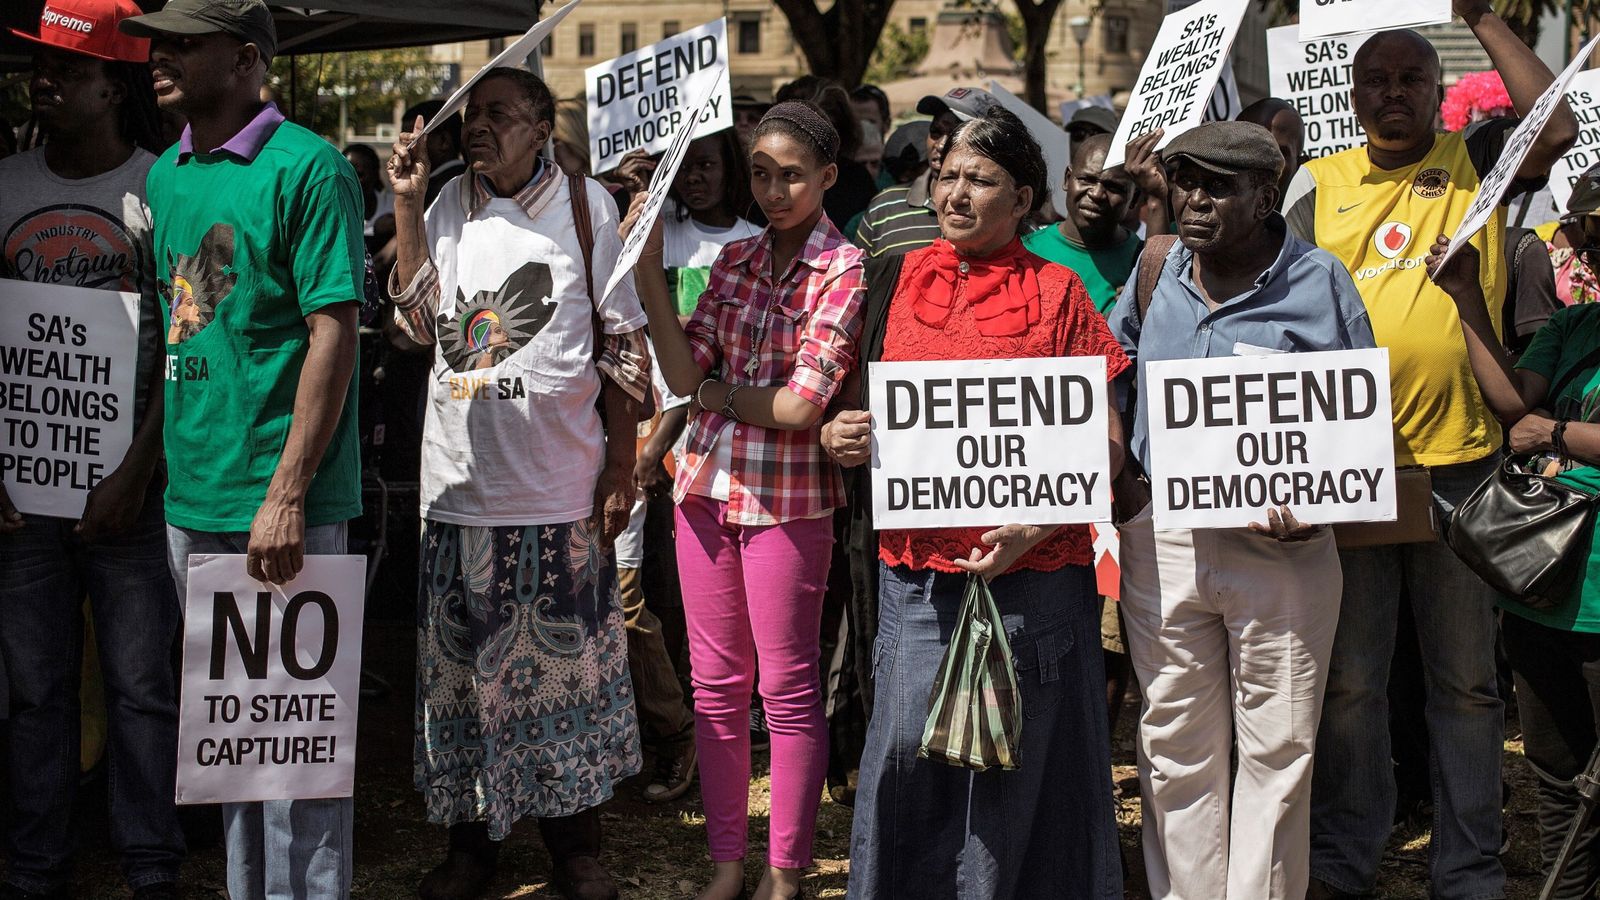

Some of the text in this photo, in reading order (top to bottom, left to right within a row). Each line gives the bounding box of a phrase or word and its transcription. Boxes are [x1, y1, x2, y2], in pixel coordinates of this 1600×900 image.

[42, 6, 93, 33] Supreme
[1181, 13, 1218, 40] SA's
[1156, 27, 1225, 69] WEALTH
[1304, 40, 1348, 64] SA's
[596, 35, 718, 108] DEFEND
[1139, 49, 1220, 95] BELONGS
[1287, 64, 1353, 93] WEALT
[637, 86, 679, 119] OUR
[1142, 77, 1201, 115] TO THE
[1127, 101, 1194, 141] PEOPLE
[1562, 152, 1589, 171] TO
[35, 225, 98, 242] INDUSTRY
[27, 313, 87, 347] SA's
[0, 346, 111, 385] WEALTH
[184, 356, 210, 382] SA
[450, 376, 526, 400] SAVE SA
[886, 375, 1093, 430] DEFEND
[1163, 368, 1377, 430] DEFEND
[4, 418, 100, 456] TO THE
[956, 434, 1027, 469] OUR
[1236, 430, 1309, 467] OUR
[0, 453, 104, 491] PEOPLE
[1167, 468, 1384, 511] DEMOCRACY
[887, 472, 1099, 511] DEMOCRACY
[209, 591, 339, 681] NO
[204, 693, 337, 724] TO STATE
[196, 735, 337, 767] CAPTURE!
